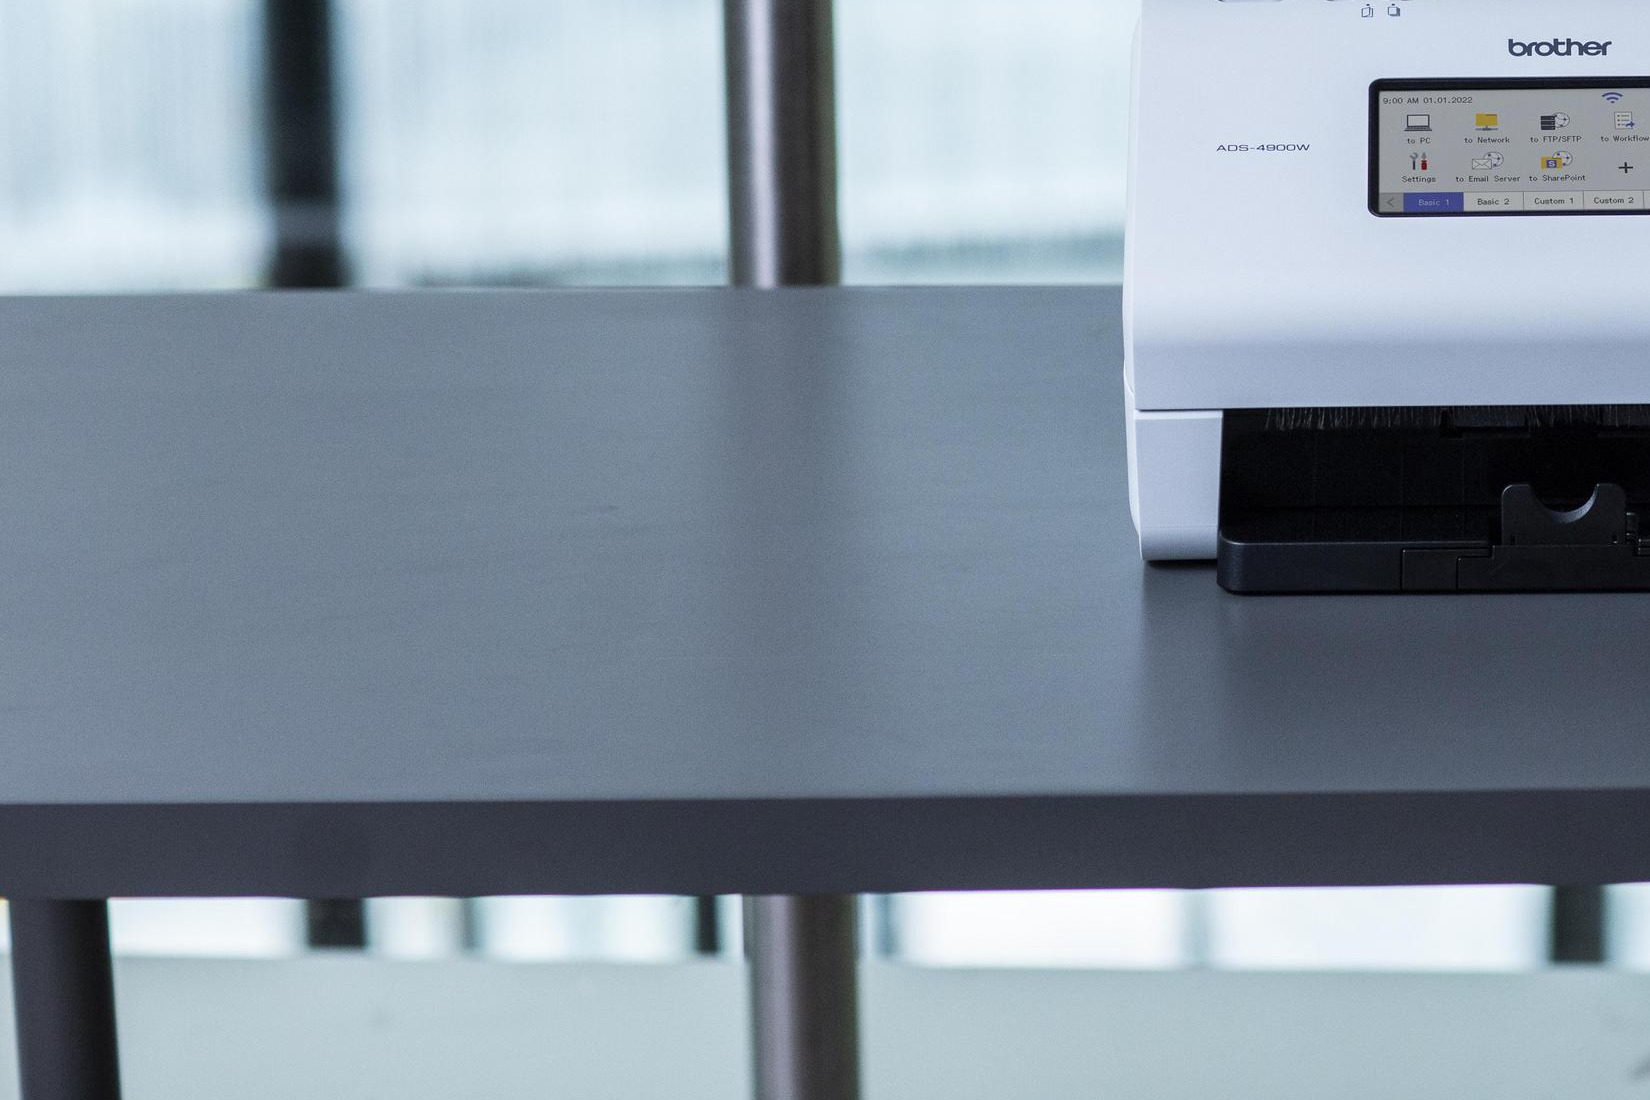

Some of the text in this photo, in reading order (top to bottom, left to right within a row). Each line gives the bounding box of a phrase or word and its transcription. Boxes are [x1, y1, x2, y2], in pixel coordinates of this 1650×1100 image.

[1508, 37, 1612, 57] brother
[1423, 96, 1473, 104] 01.01.2022
[1477, 136, 1510, 144] Network
[1613, 134, 1650, 142] Workflow
[1216, 144, 1311, 152] ADS-4900W
[1402, 176, 1436, 184] Settings
[1542, 174, 1586, 182] SharePoint
[1418, 198, 1441, 206] Basic
[1478, 198, 1500, 206] Basic
[1628, 196, 1634, 204] 2
